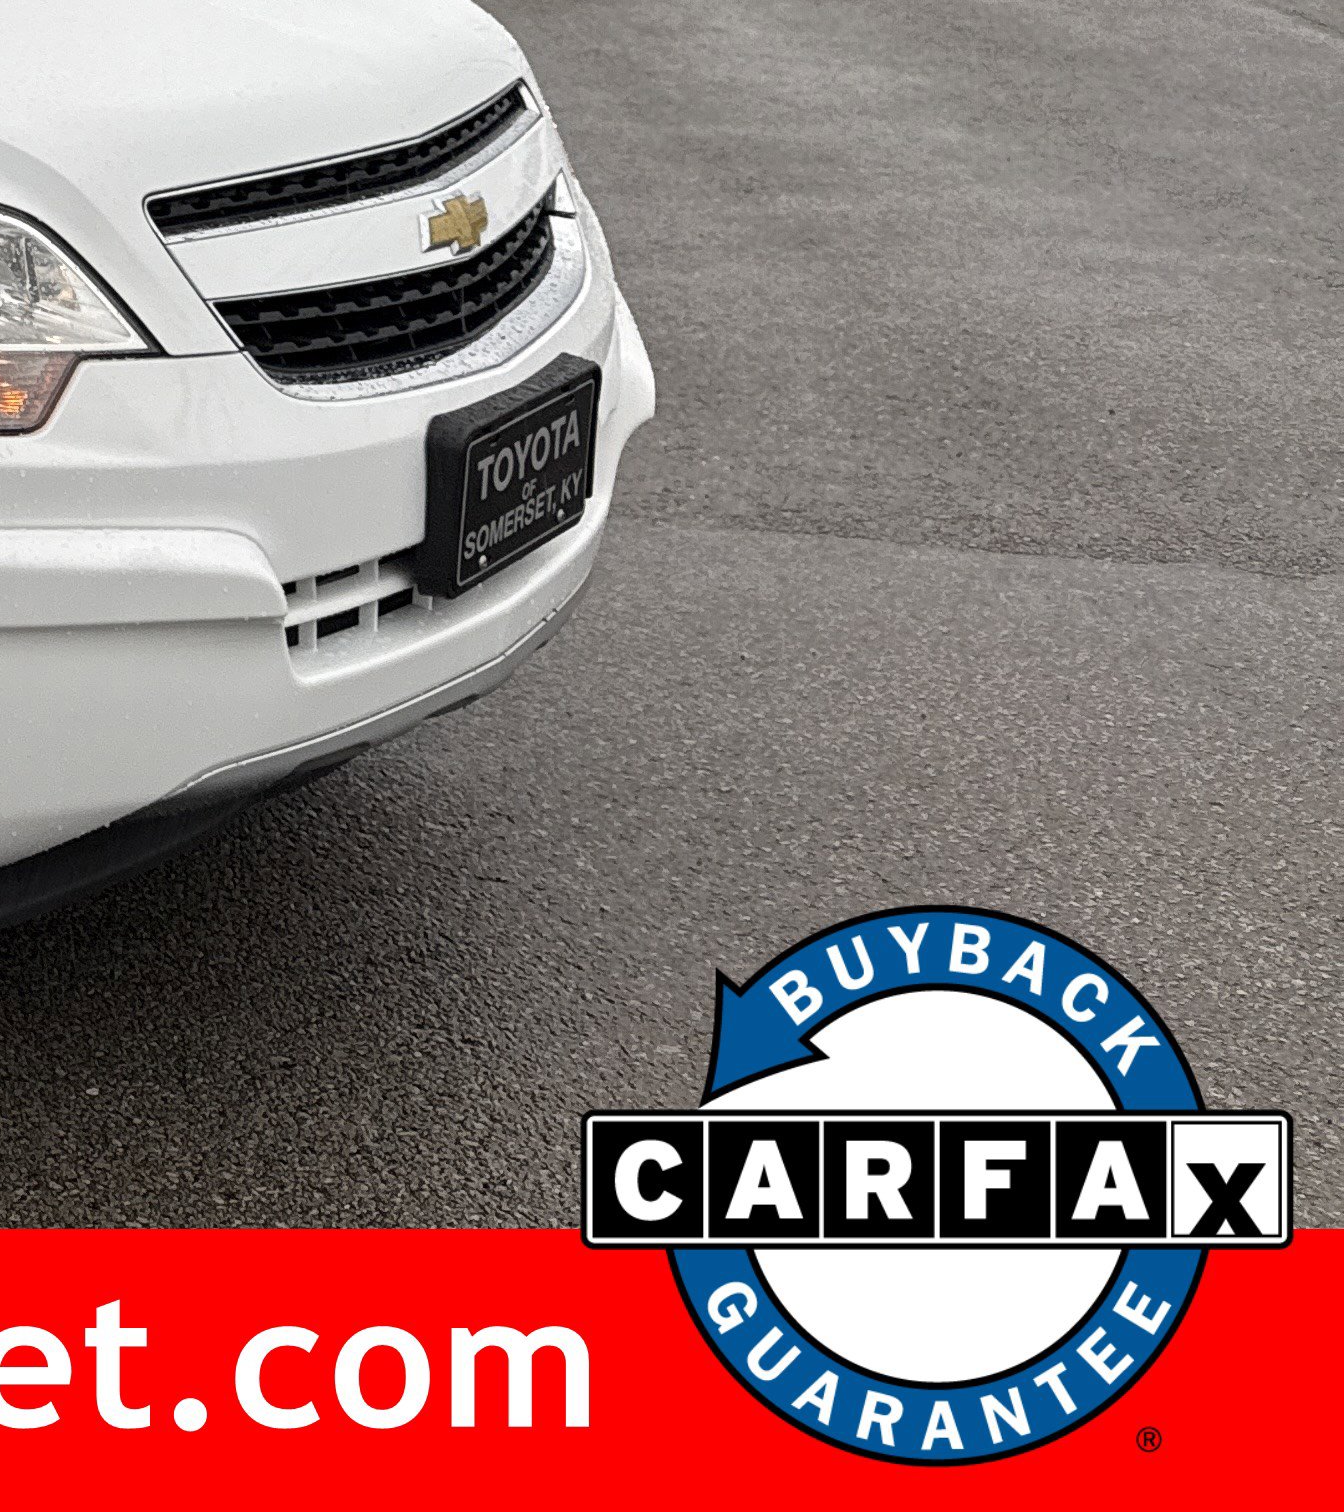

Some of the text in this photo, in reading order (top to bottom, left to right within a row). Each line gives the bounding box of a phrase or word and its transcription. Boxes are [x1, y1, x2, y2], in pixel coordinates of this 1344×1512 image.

[477, 410, 580, 500] TOYOTA
[522, 478, 537, 501] OF
[464, 469, 583, 560] SOMERSET, KY
